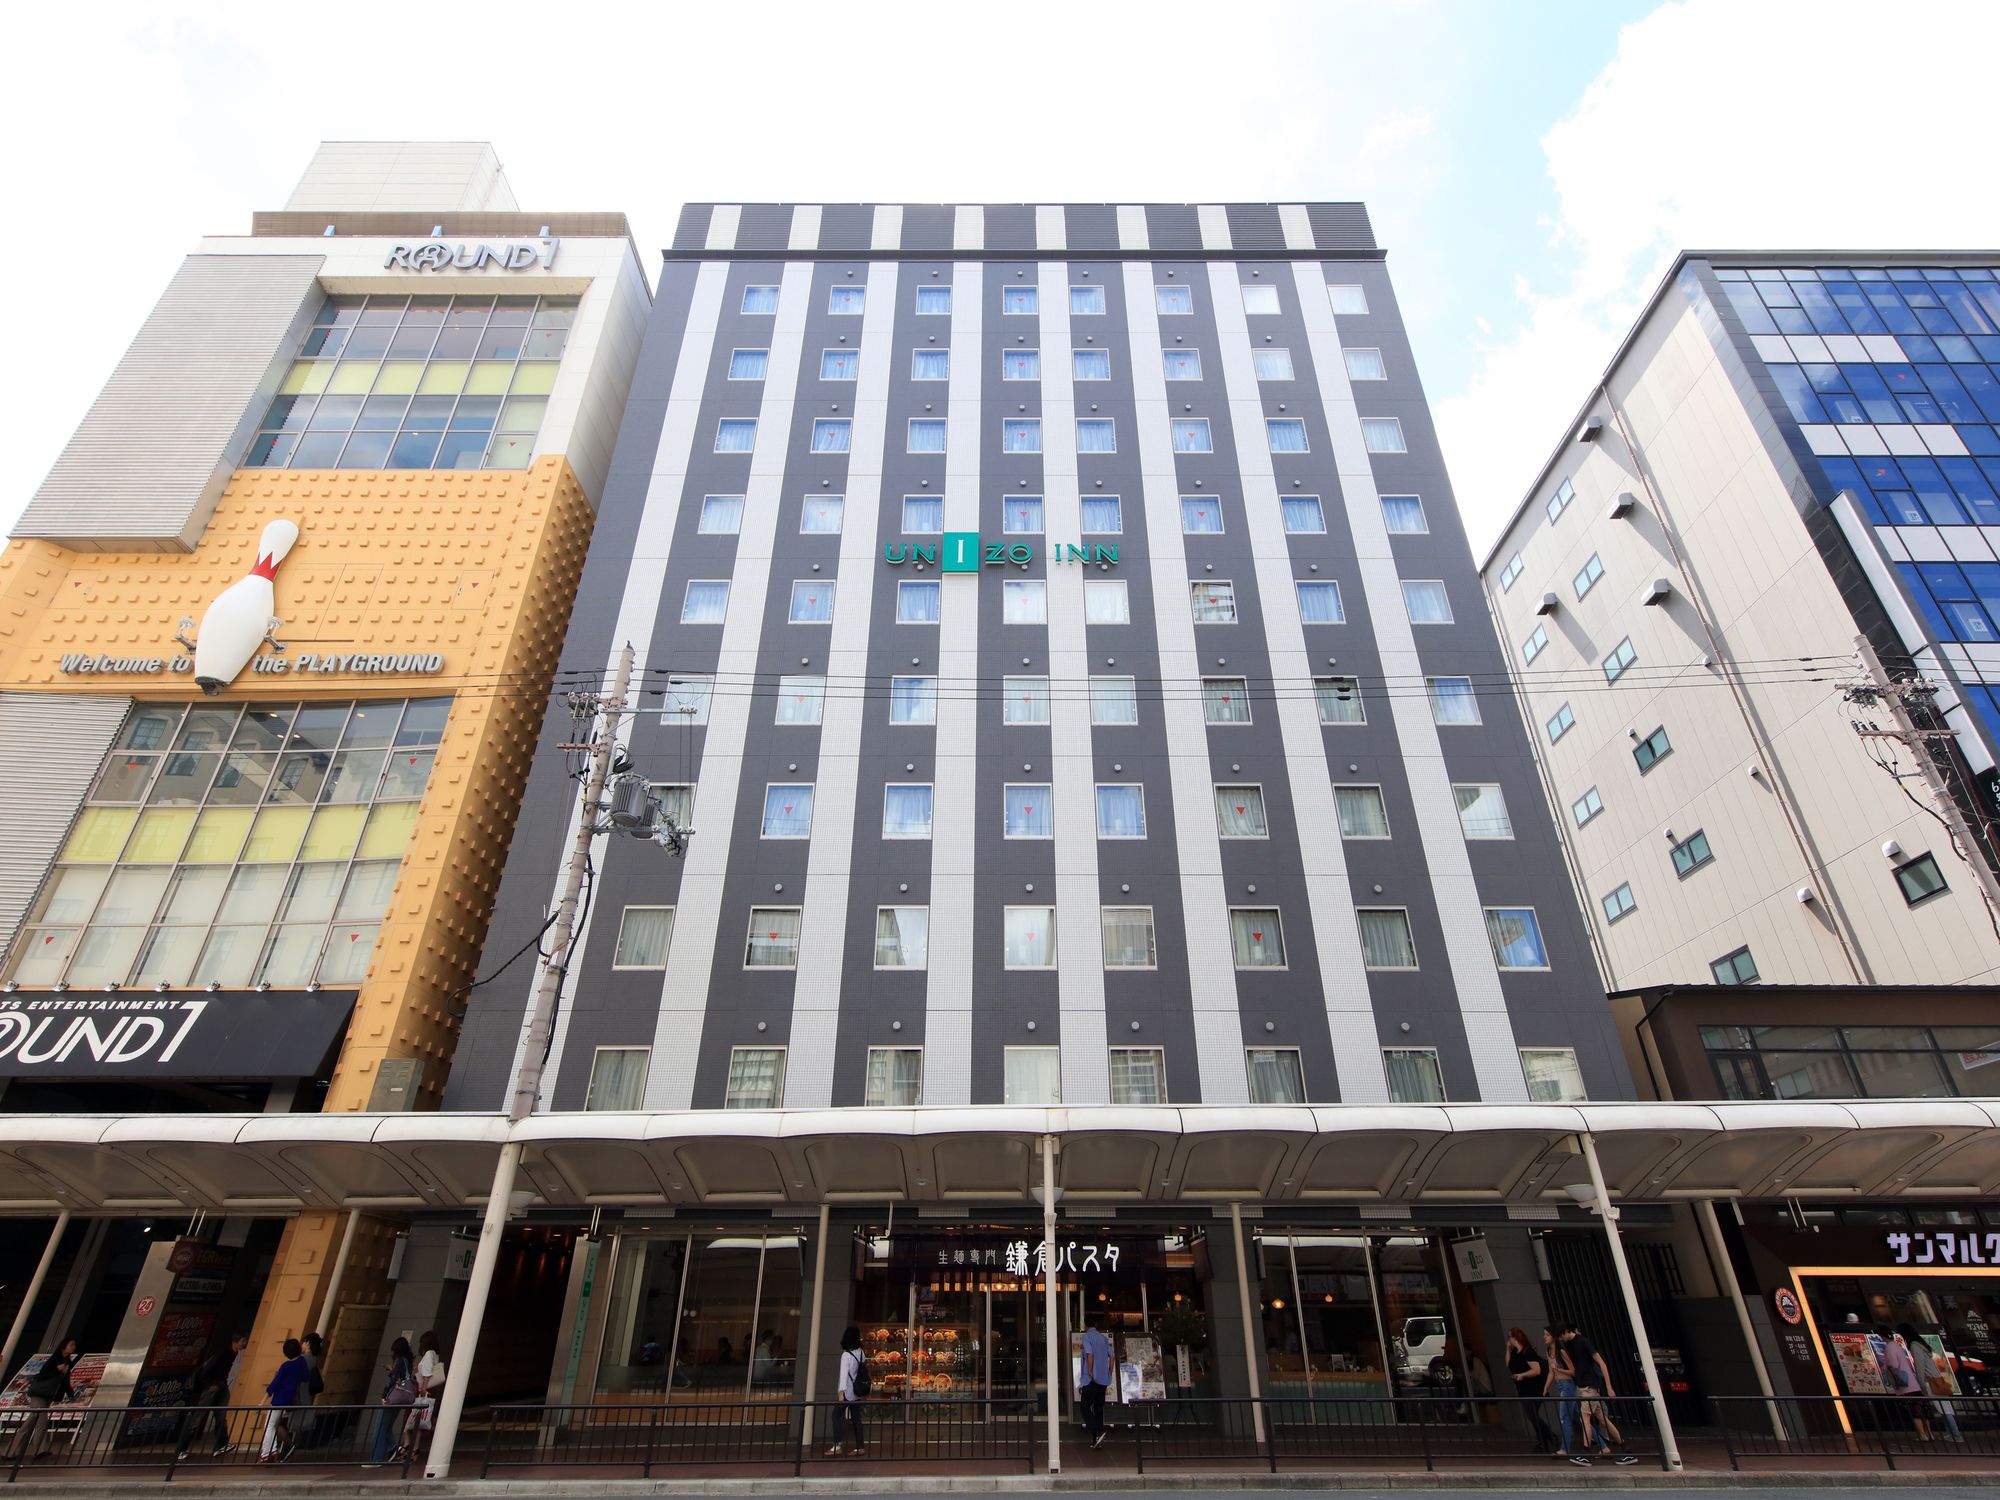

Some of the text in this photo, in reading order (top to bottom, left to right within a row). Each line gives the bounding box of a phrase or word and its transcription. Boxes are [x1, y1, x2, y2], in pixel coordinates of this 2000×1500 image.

[884, 538, 1119, 567] UNIZO INN
[59, 652, 446, 676] Welcome to the PLAYGROUND
[26, 1000, 181, 1011] ENTERTAINMENT
